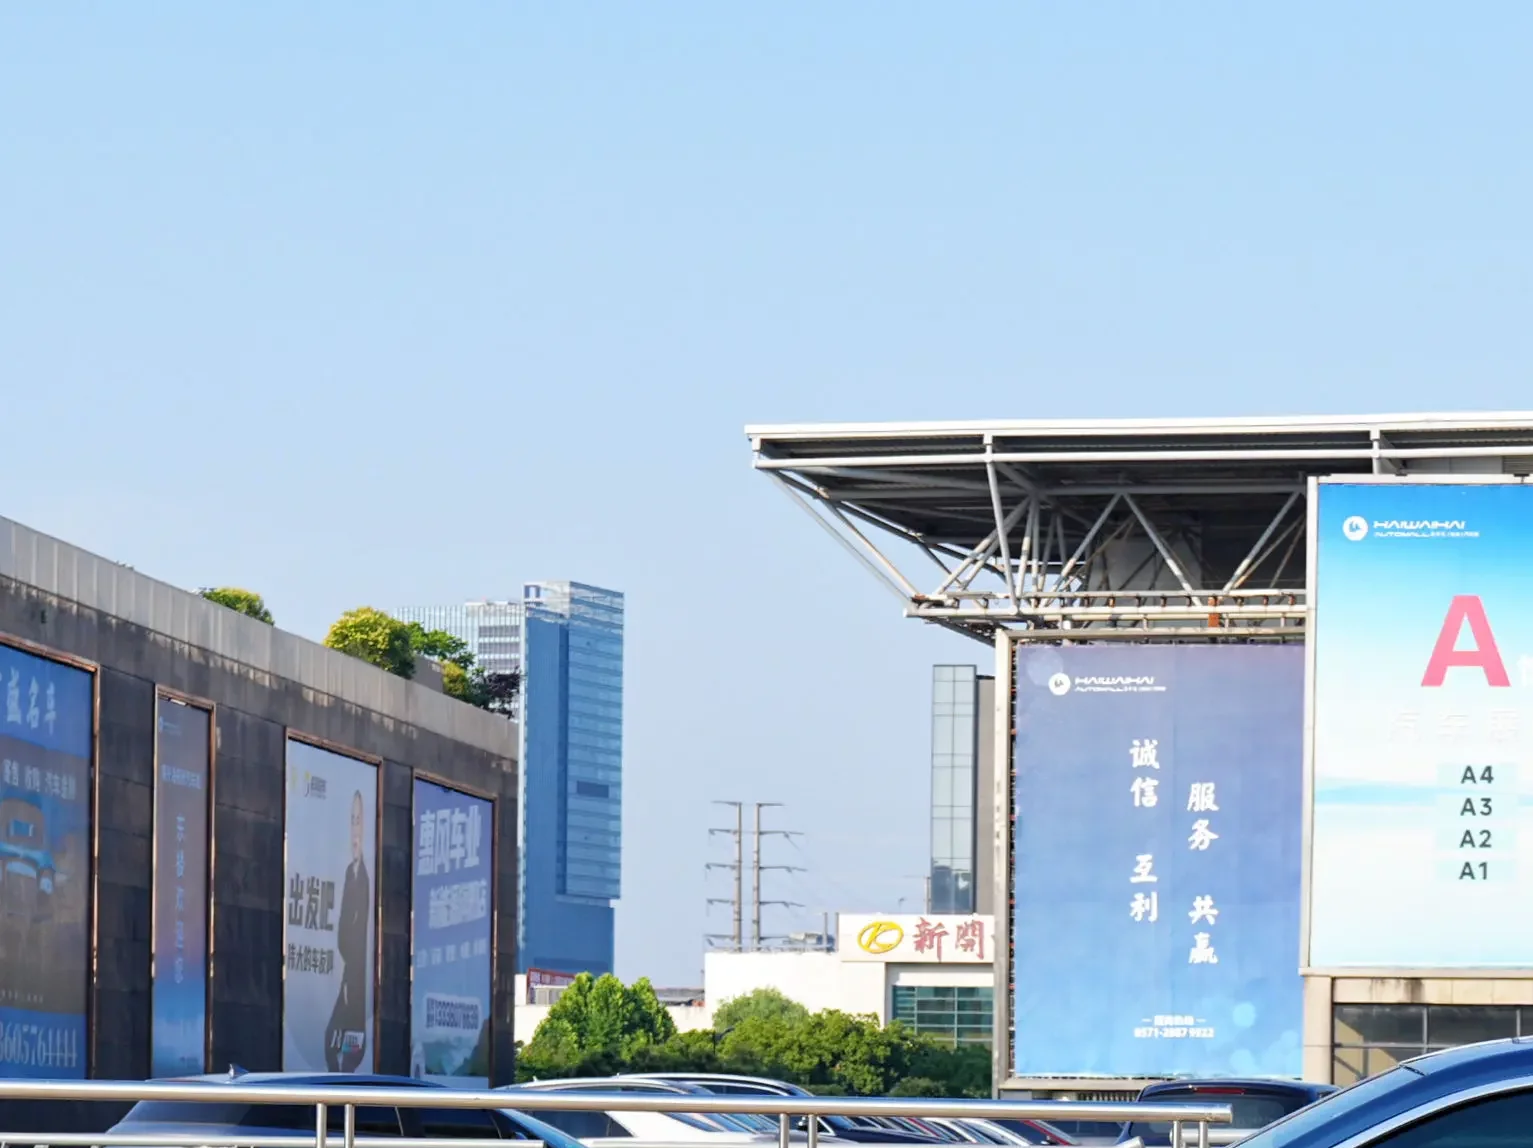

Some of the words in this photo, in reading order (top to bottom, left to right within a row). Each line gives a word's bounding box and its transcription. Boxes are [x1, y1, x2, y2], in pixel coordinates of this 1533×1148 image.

[1421, 595, 1511, 686] A
[0, 666, 57, 736] 益名车
[1129, 739, 1160, 807] 诚信
[1460, 765, 1494, 784] A4
[1460, 798, 1492, 816] A3
[1186, 782, 1219, 850] 服务
[1459, 830, 1492, 848] A2
[288, 872, 336, 931] 出发吧
[1129, 854, 1158, 923] 互利
[1459, 862, 1488, 880] A1
[1188, 894, 1218, 964] 共赢
